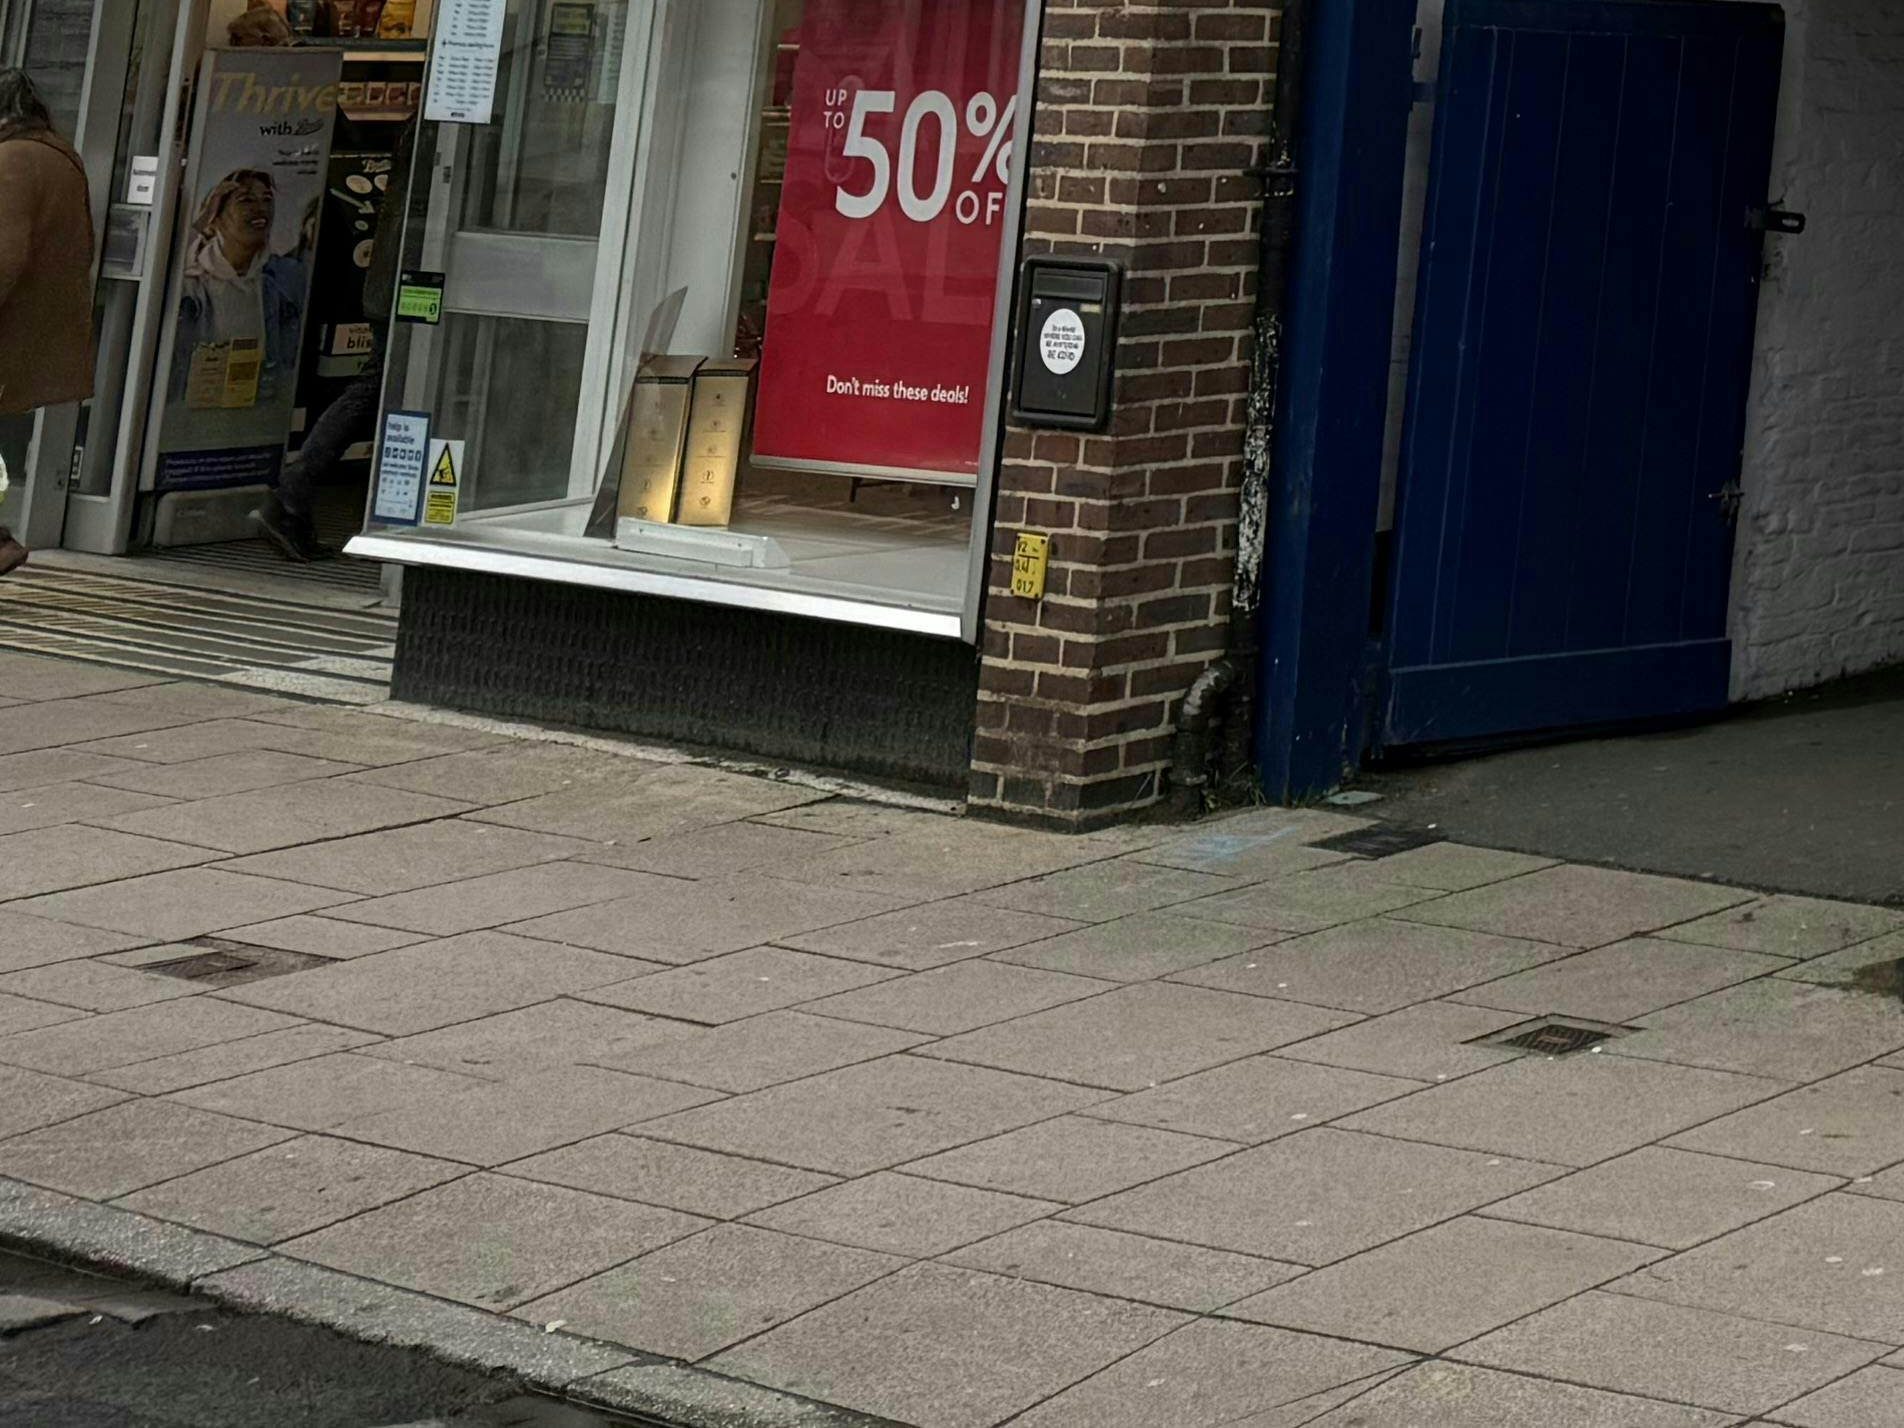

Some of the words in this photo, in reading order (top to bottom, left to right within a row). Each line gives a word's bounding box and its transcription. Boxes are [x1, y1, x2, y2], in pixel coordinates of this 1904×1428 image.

[212, 72, 338, 113] Thrive
[825, 89, 848, 106] UP
[259, 120, 292, 136] with
[823, 111, 845, 129] TO
[835, 89, 1017, 223] 50%
[955, 190, 1003, 225] OF
[826, 374, 860, 395] Don't
[862, 378, 890, 398] miss
[893, 380, 928, 401] these
[930, 383, 969, 404] deals!
